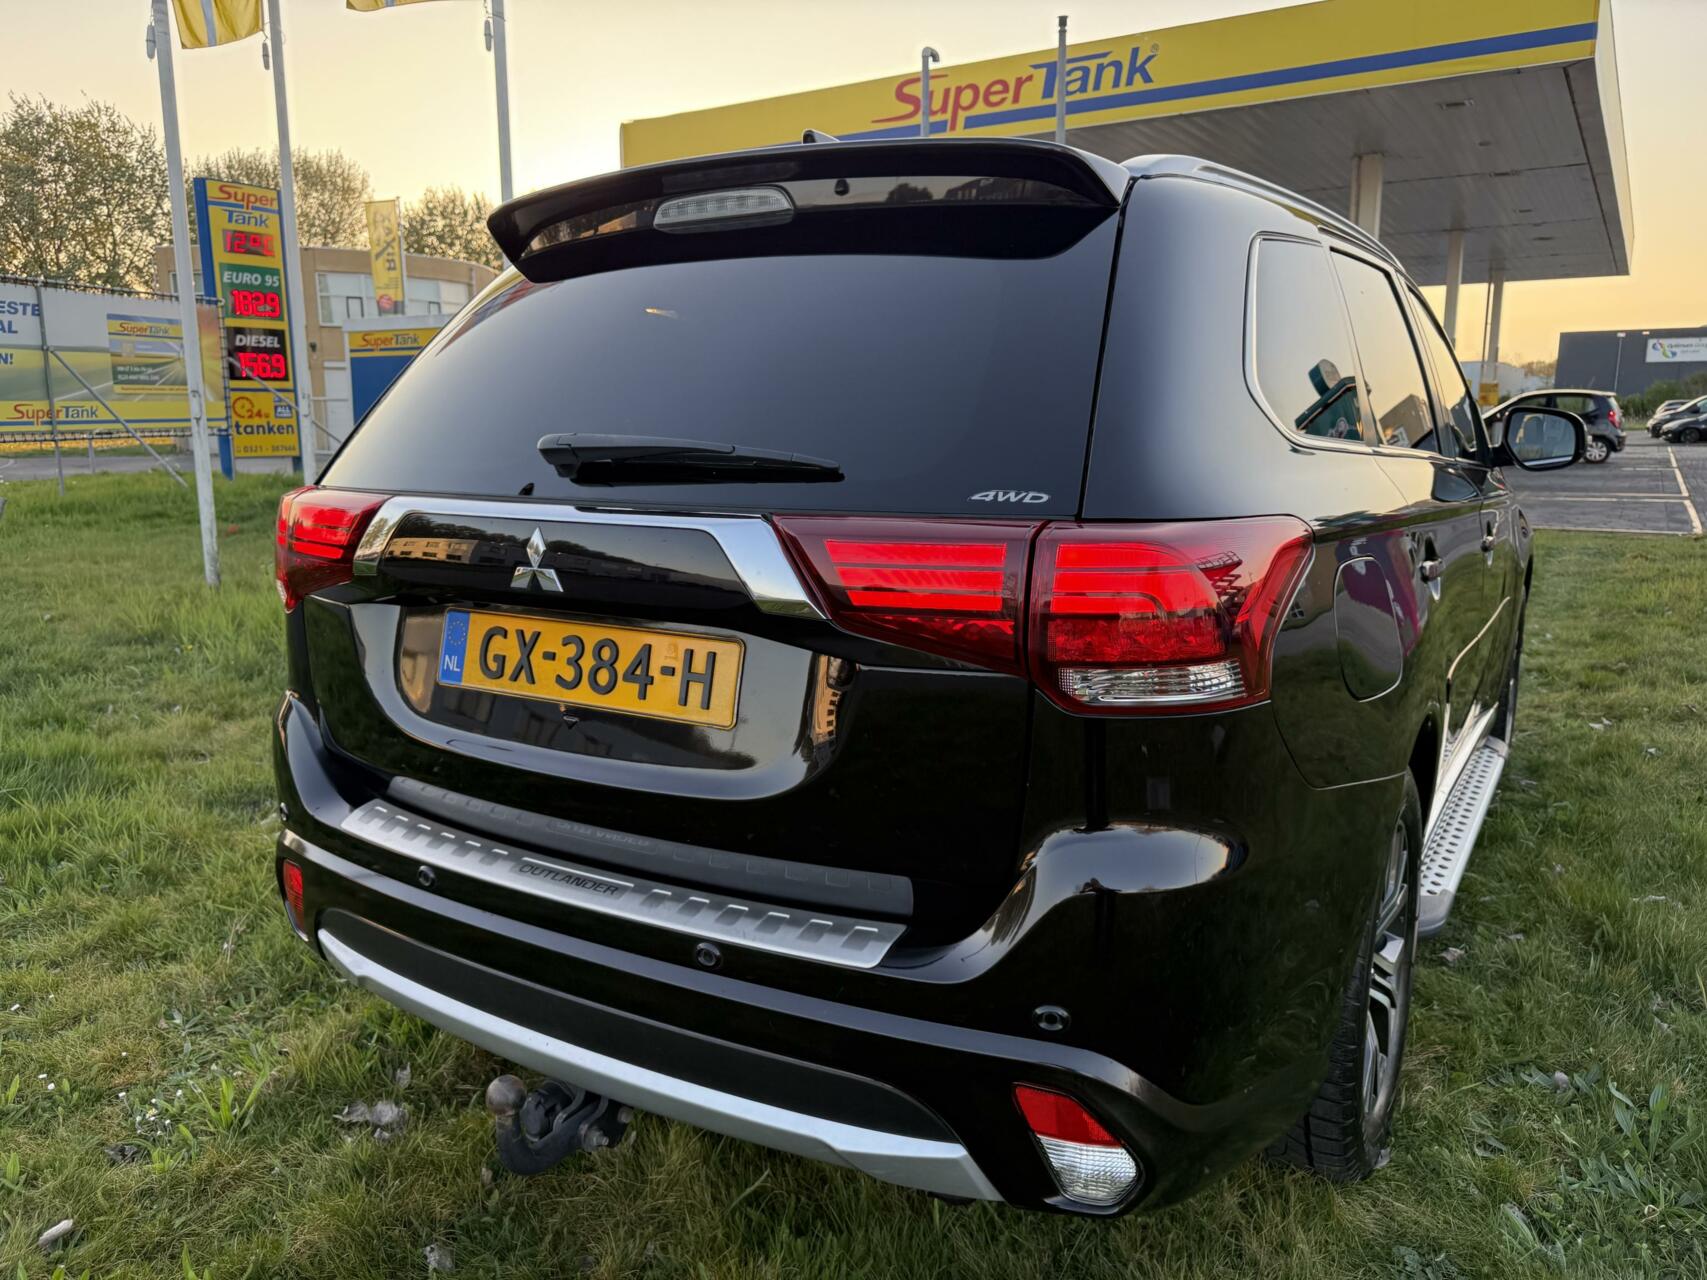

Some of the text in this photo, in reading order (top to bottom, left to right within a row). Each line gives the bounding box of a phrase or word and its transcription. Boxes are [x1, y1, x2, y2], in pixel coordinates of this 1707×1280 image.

[208, 183, 277, 211] Super
[222, 208, 270, 228] Tank
[223, 271, 280, 288] EURO 95
[235, 334, 280, 348] DIESEL
[234, 421, 296, 436] tanken
[969, 489, 1050, 504] 4WD
[443, 654, 461, 673] NL
[478, 625, 717, 711] GX-384-H
[519, 863, 619, 896] OUTLANDER
